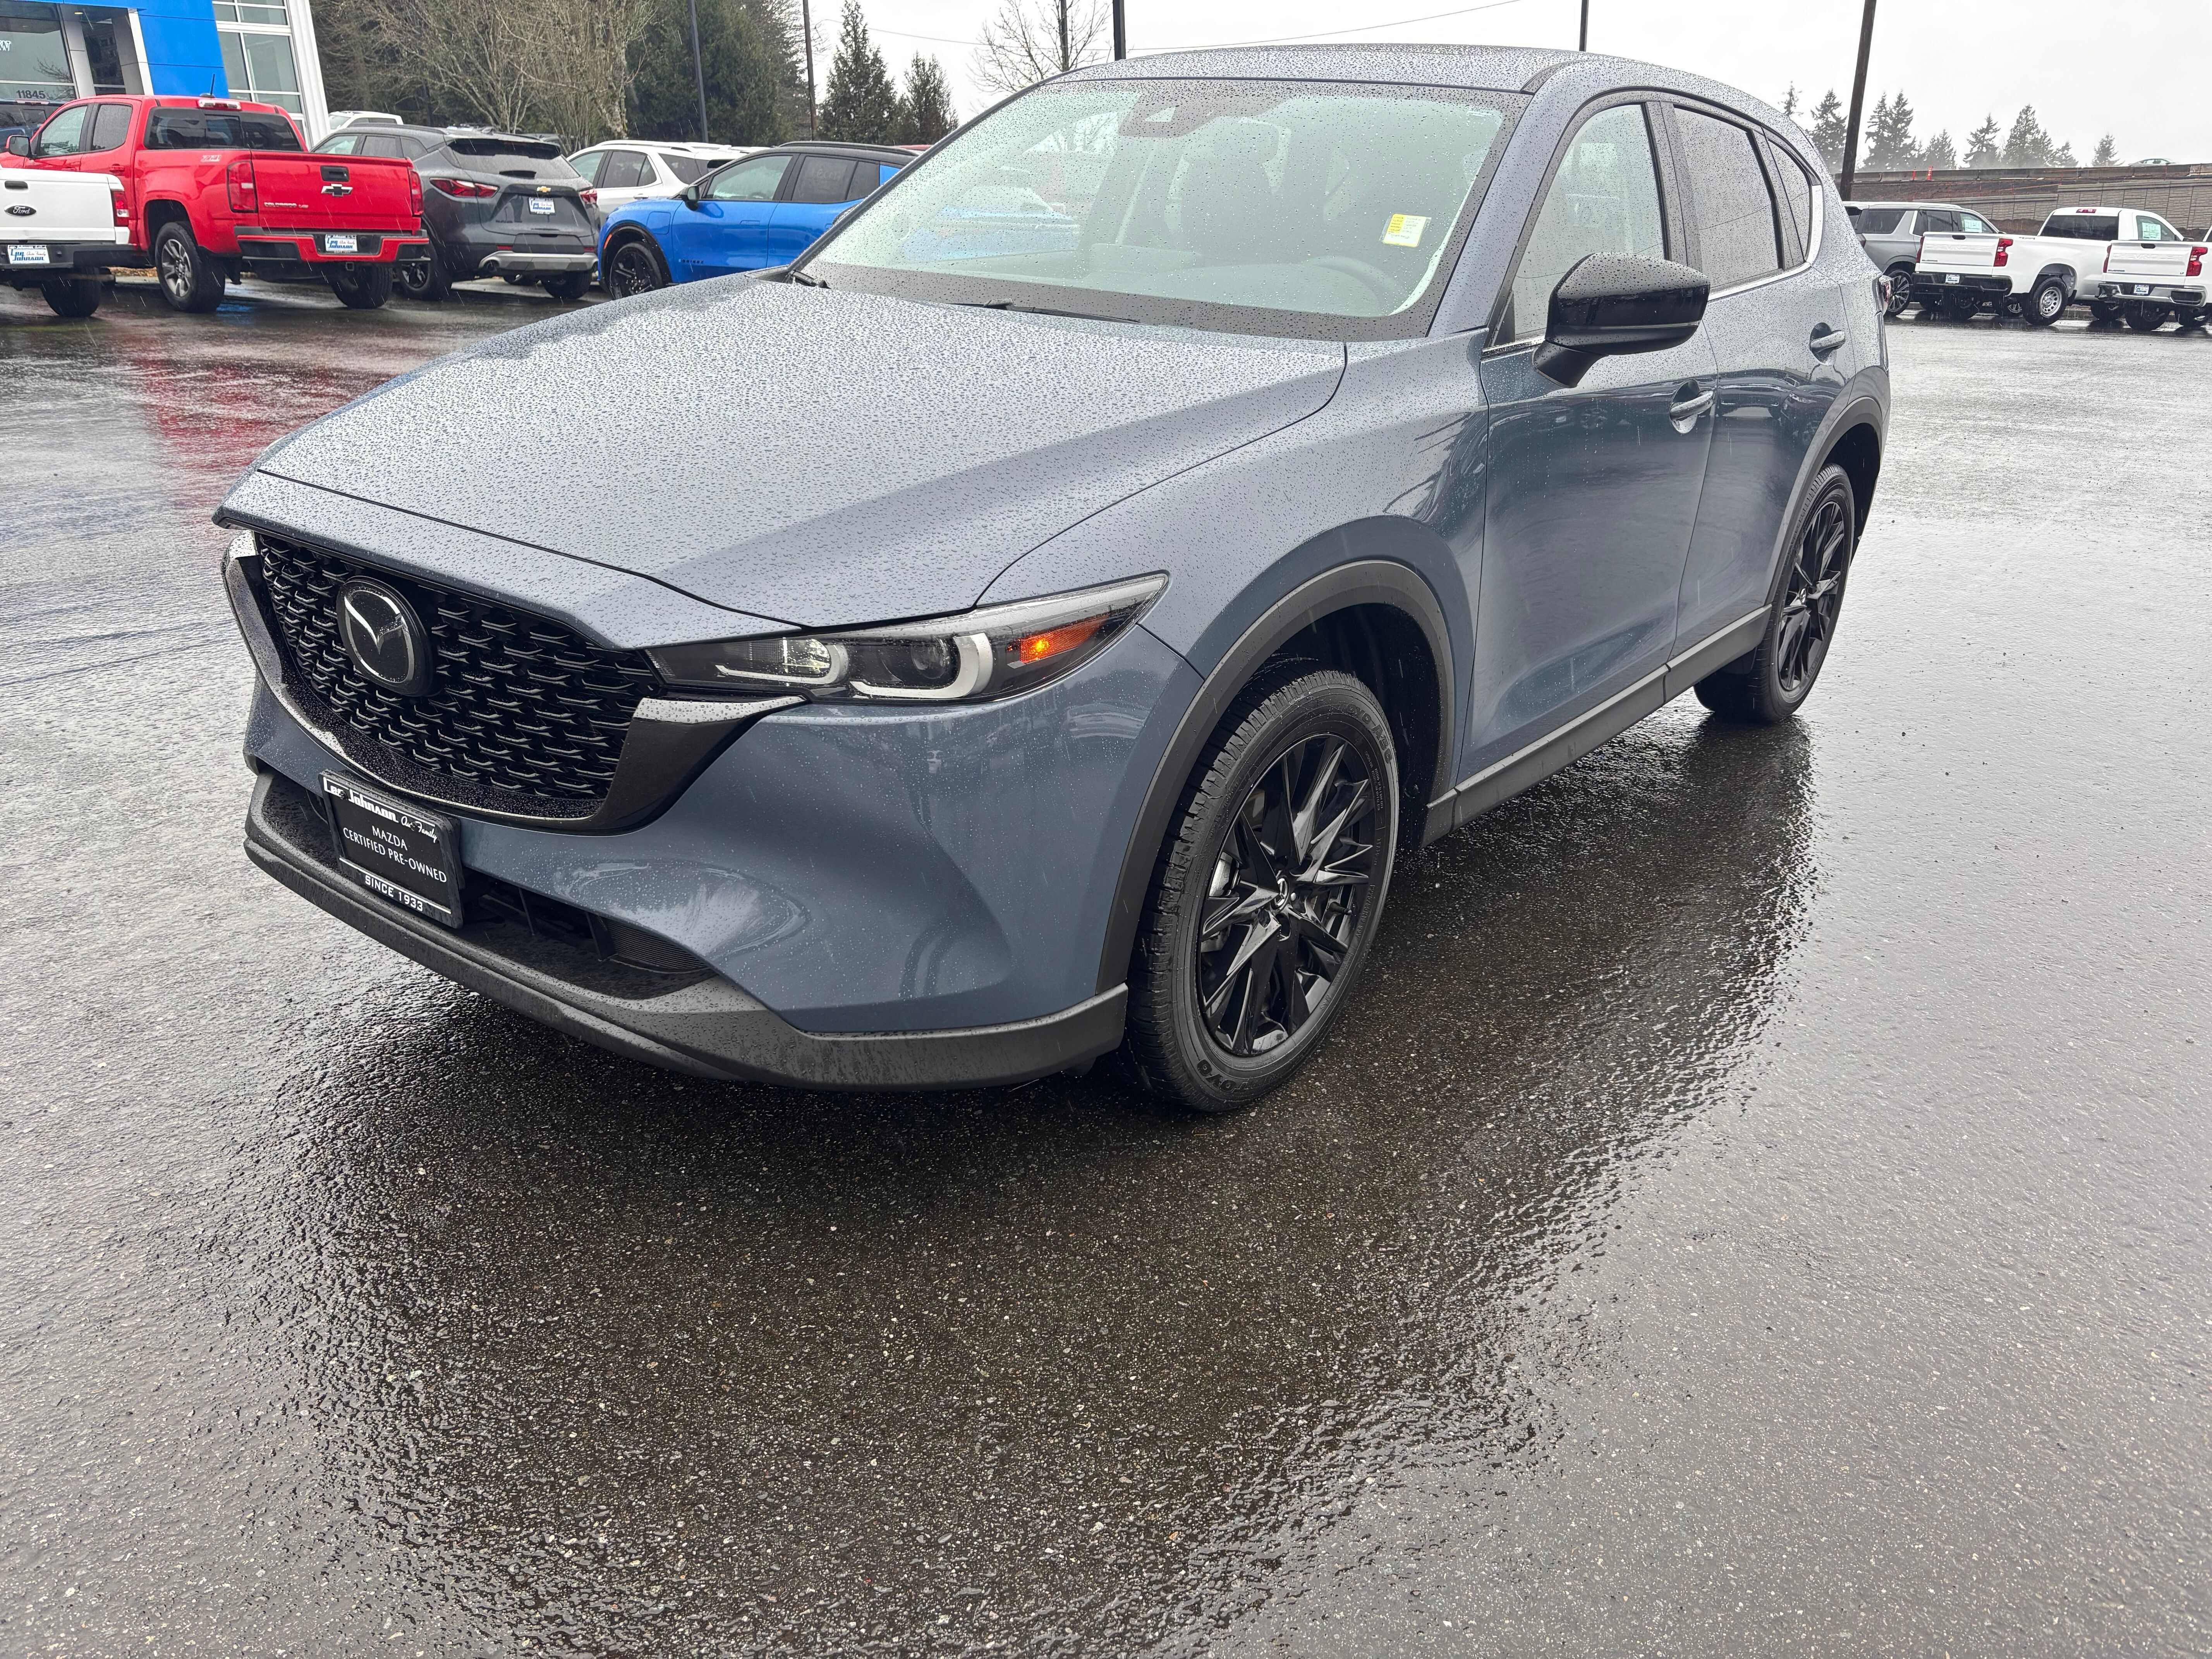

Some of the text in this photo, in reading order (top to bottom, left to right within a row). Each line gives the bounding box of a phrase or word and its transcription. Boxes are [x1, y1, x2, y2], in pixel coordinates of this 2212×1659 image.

[16, 90, 46, 99] 11845
[13, 206, 30, 214] Ford
[348, 788, 399, 823] Johnson
[415, 821, 437, 843] Family
[372, 825, 408, 851] MAZDA
[343, 827, 447, 883] CERTIFIED PRE-OWNED
[365, 874, 423, 912] SINCE 1933
